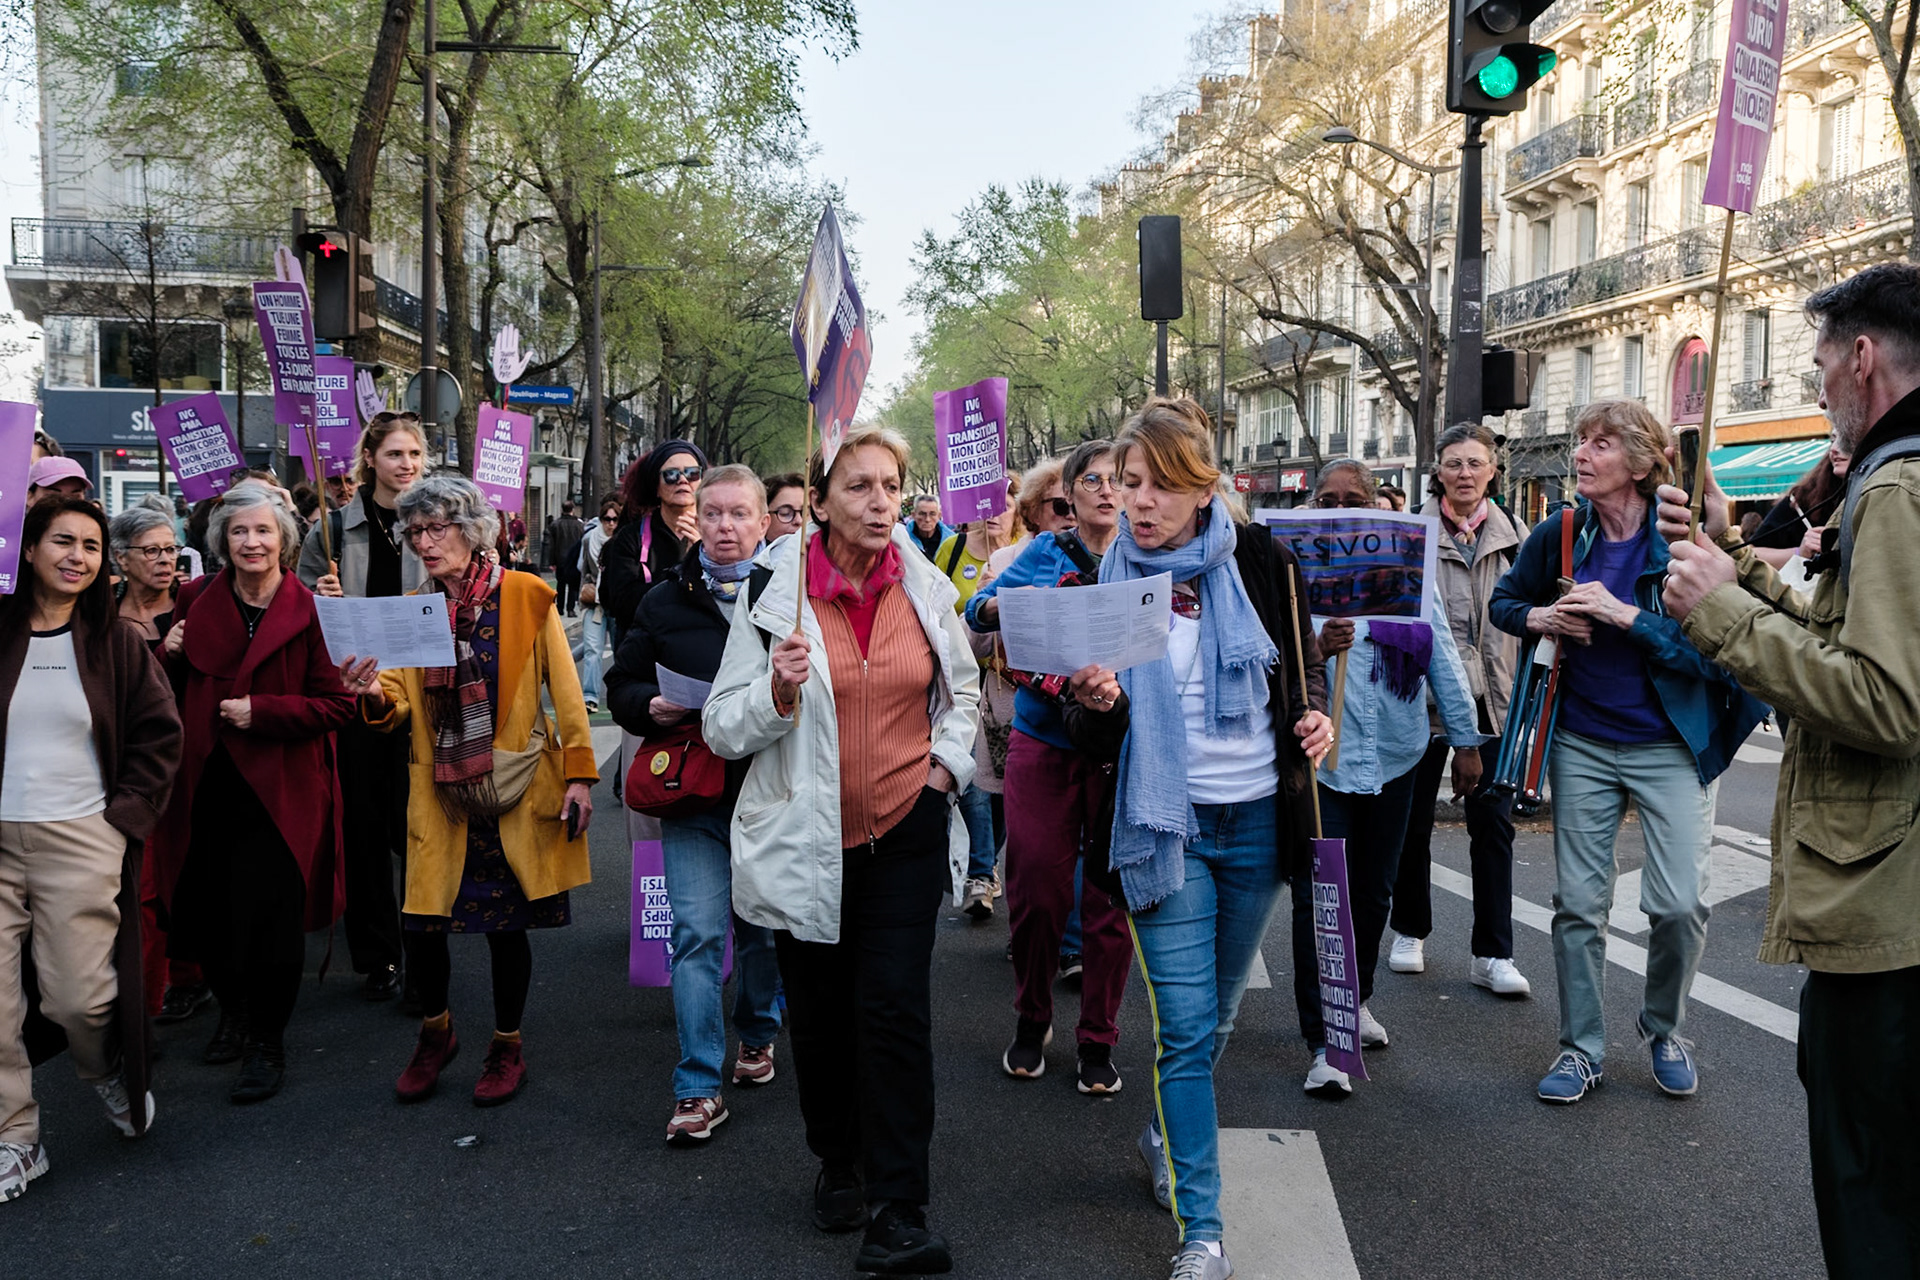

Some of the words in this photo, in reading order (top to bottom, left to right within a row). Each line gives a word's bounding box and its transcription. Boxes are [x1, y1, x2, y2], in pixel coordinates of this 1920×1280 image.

[258, 294, 273, 307] UN
[273, 294, 302, 309] HOMME
[285, 312, 301, 326] UNE
[295, 346, 311, 360] LES
[291, 363, 315, 378] OURS
[317, 377, 345, 388] TURE
[509, 389, 540, 398] épublique
[316, 406, 334, 417] IOL
[965, 397, 980, 412] IVG
[178, 408, 195, 421] IVG
[964, 411, 984, 428] PMA
[180, 418, 203, 432] PMA
[497, 420, 511, 431] IVG
[168, 424, 222, 446] TRANSITION
[494, 430, 511, 442] PMA
[947, 421, 998, 446] TRANSITION
[175, 444, 198, 456] MON
[197, 435, 226, 449] CORPS
[482, 438, 523, 455] TRANSITION
[951, 445, 975, 460] MON
[975, 436, 999, 455] CORPS
[180, 454, 201, 466] MON
[201, 446, 229, 460] CHOIX
[481, 450, 497, 460] MON
[497, 452, 522, 465] CORPS
[952, 460, 977, 475] MON
[977, 451, 998, 469] CHOIX
[181, 466, 201, 478] MES
[480, 461, 496, 472] MON
[497, 463, 519, 475] CHOIX
[477, 471, 490, 481] MES
[949, 475, 972, 489] MES
[1290, 538, 1330, 560] ES
[1337, 533, 1420, 557] VOIX
[1310, 571, 1422, 604] BELLES
[648, 878, 667, 891] ITS
[647, 894, 669, 907] OIX
[644, 910, 673, 923] ORPS
